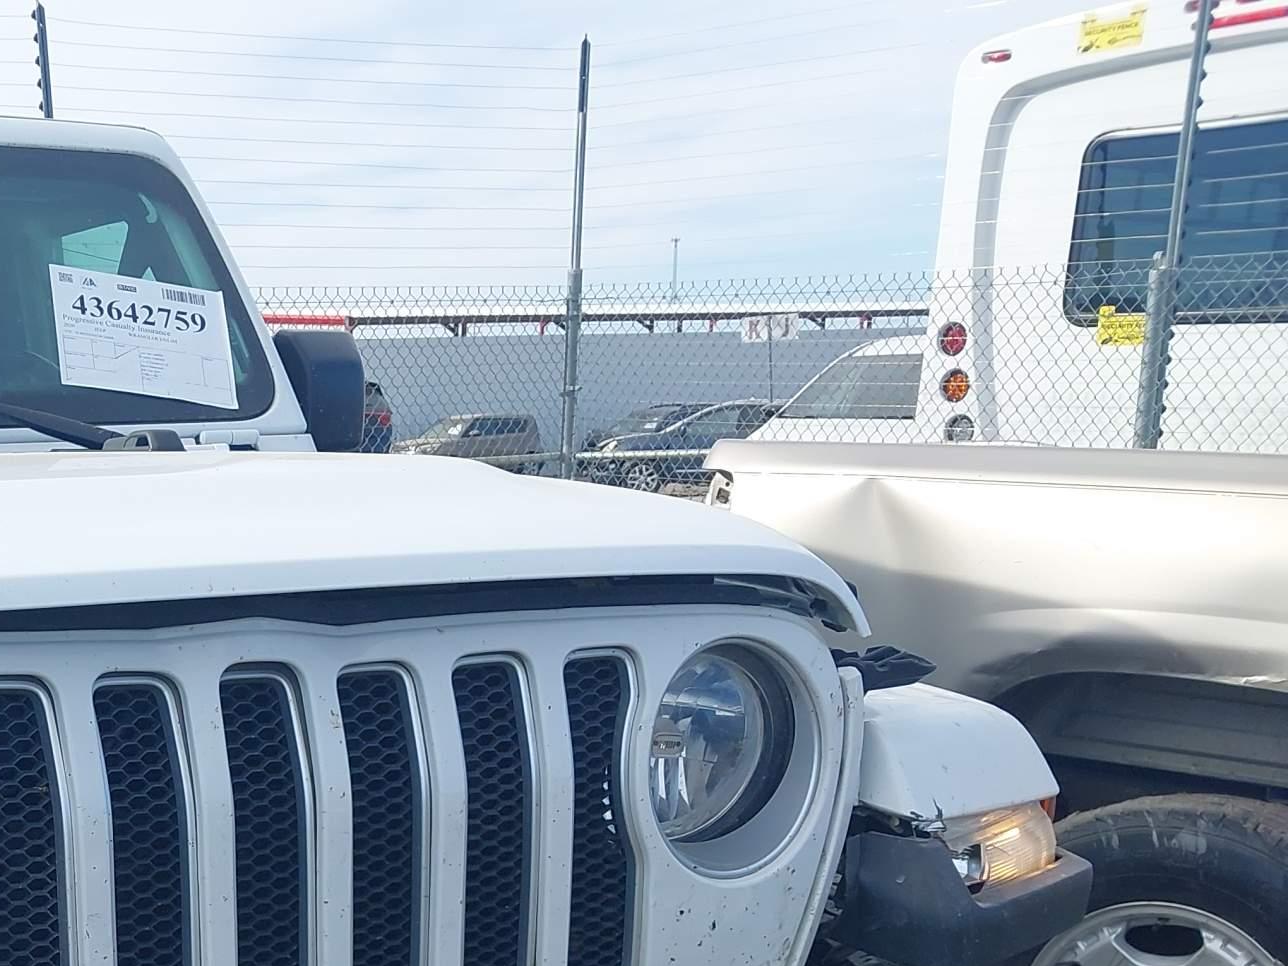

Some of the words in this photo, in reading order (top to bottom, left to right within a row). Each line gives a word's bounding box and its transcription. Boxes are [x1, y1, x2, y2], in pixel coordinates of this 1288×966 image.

[72, 294, 206, 334] 43642759
[105, 319, 136, 332] Casualty
[137, 325, 172, 337] Insurance
